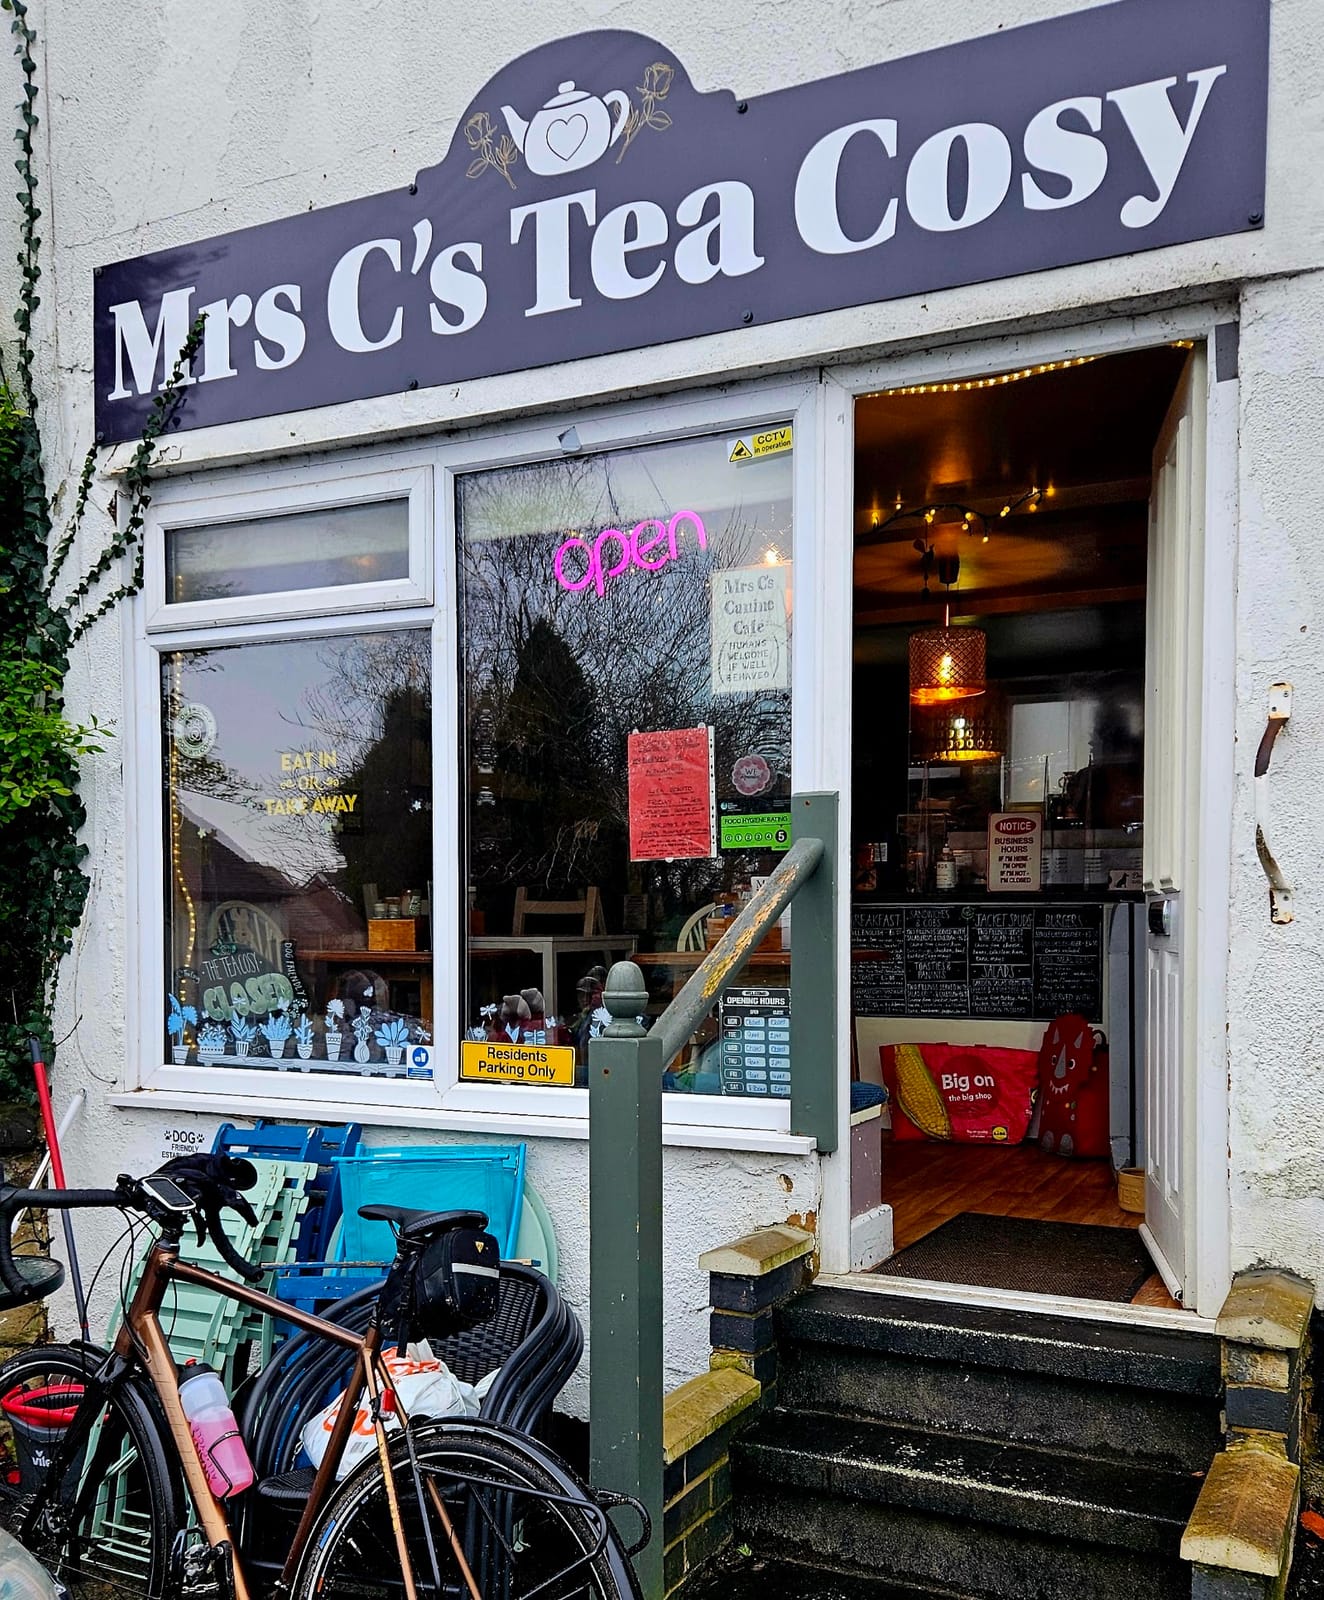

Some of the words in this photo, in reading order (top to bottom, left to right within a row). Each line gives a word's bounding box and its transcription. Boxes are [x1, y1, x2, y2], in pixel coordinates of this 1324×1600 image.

[107, 283, 306, 401] Mrs
[327, 218, 488, 353] C's
[508, 181, 765, 318] Tea
[794, 64, 1227, 255] Cosy
[757, 430, 786, 445] CCTV
[762, 440, 791, 453] operation
[554, 510, 708, 597] open
[724, 579, 753, 594] Mrs
[758, 575, 774, 590] C's
[724, 599, 774, 615] Canine
[727, 650, 768, 660] WELCOME
[729, 662, 737, 671] IF
[742, 660, 766, 669] WELL
[727, 671, 769, 681] BEHAVED
[281, 751, 312, 771] EAT
[319, 750, 337, 768] IN
[299, 776, 325, 790] OR
[265, 796, 308, 816] TAKE
[312, 794, 358, 814] AWAY
[1000, 821, 1032, 831] NOTICE
[995, 837, 1034, 845] BUSINESS
[975, 913, 1008, 927] JACKET
[1045, 914, 1083, 927] BURGERS
[284, 942, 294, 959] DOG
[202, 958, 222, 981] THE
[219, 956, 237, 977] TEA
[238, 952, 260, 975] COSY
[981, 965, 1014, 978] SALADS
[285, 960, 307, 996] FRIENDLY
[204, 973, 294, 1021] CLOSED
[727, 996, 759, 1004] OPENING
[759, 997, 785, 1005] HOURS
[487, 1047, 547, 1062] Residents
[478, 1061, 524, 1078] Parking
[528, 1065, 555, 1080] Only
[942, 1073, 970, 1092] Big
[974, 1075, 994, 1087] on
[949, 1094, 961, 1102] the
[962, 1093, 973, 1102] big
[975, 1092, 992, 1100] shop
[173, 1130, 195, 1144] DOG
[171, 1144, 200, 1152] FRIENDLY
